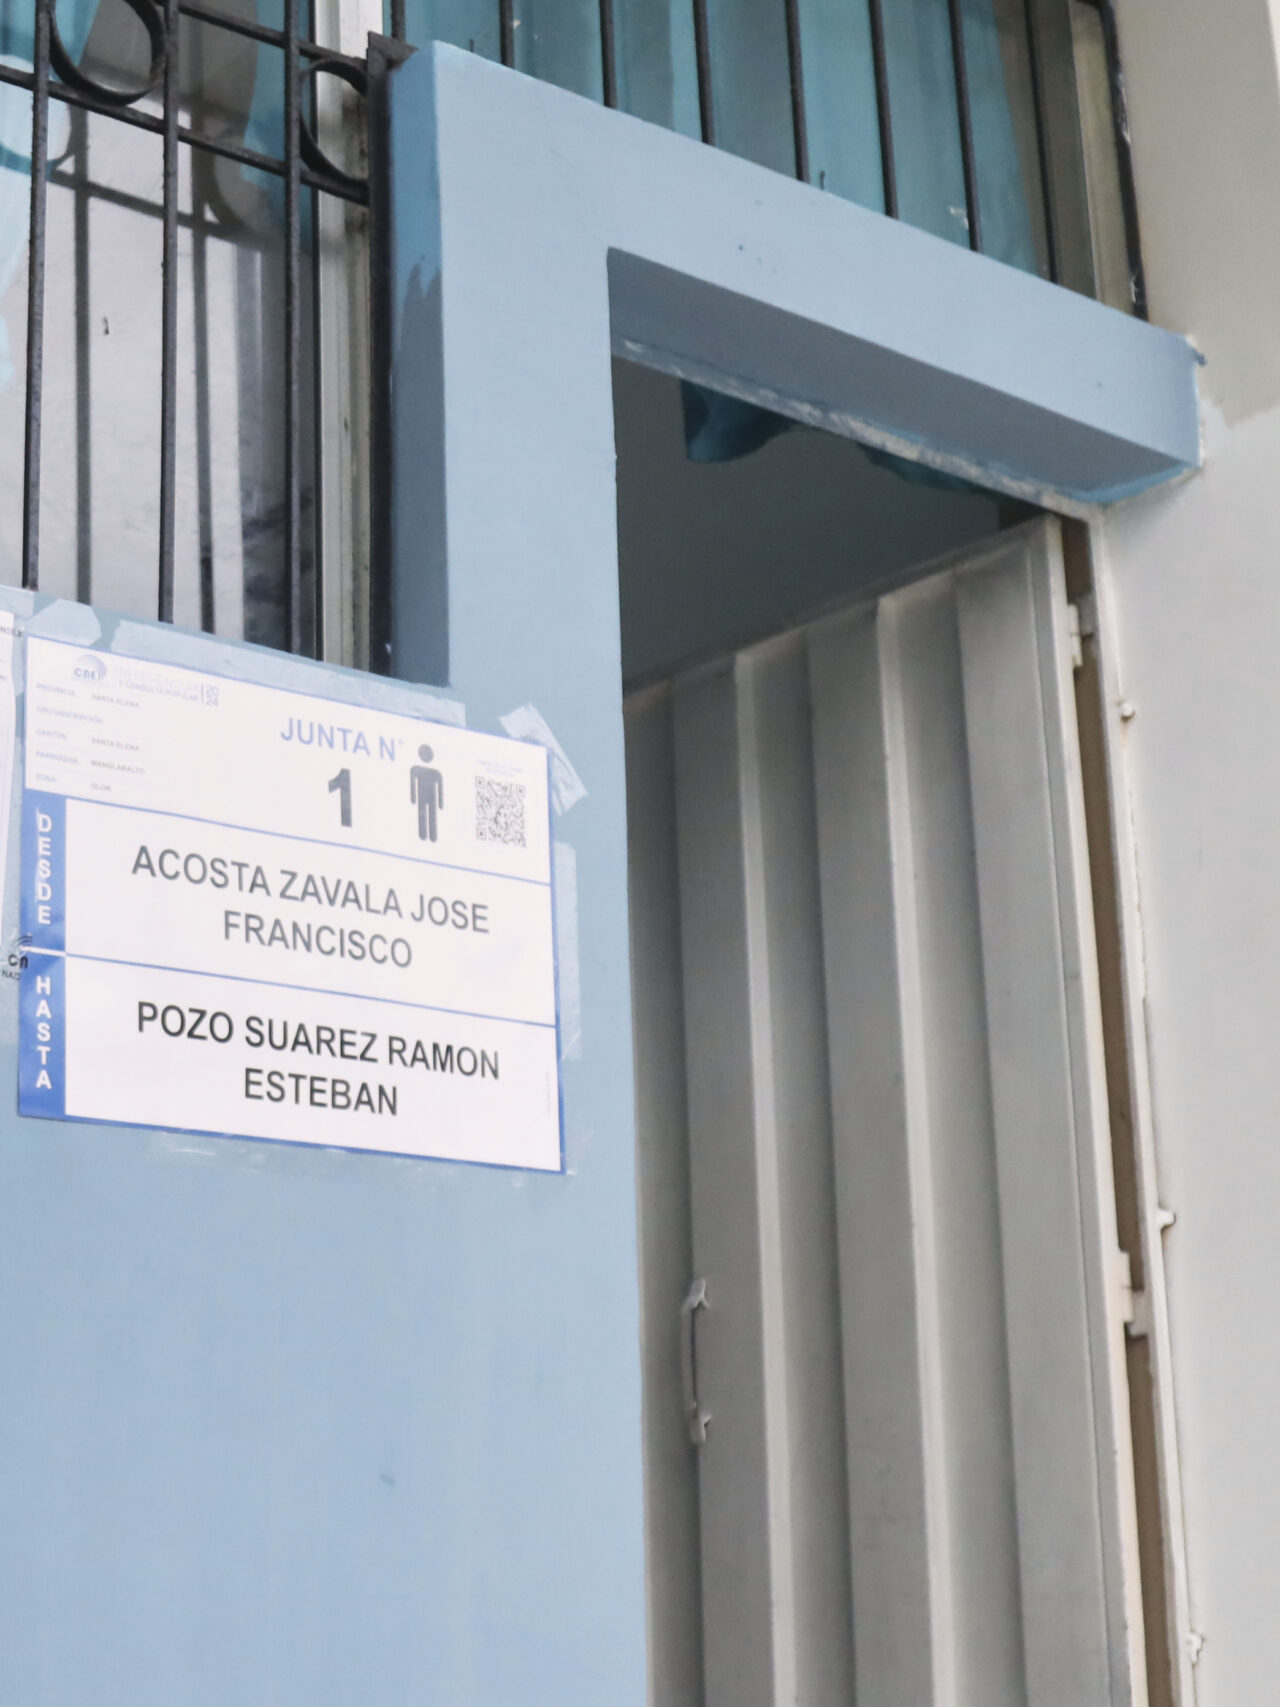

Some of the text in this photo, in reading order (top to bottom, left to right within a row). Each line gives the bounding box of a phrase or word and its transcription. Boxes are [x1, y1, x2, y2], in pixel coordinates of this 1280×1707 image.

[91, 693, 114, 704] SANTA
[116, 698, 139, 708] ELENA
[91, 736, 114, 747] SANTA
[116, 741, 140, 752] ELENA
[280, 717, 371, 757] JUNTA
[91, 759, 145, 775] MANGLARALTO
[328, 767, 352, 828] 1
[36, 812, 53, 925] DESDE
[131, 845, 490, 934] ACOSTA ZAVALA JOSE
[223, 910, 412, 968] FRANCISCO
[36, 975, 53, 1090] HASTA
[138, 1001, 500, 1080] POZO SUAREZ RAMON
[244, 1067, 397, 1116] ESTEBAN
